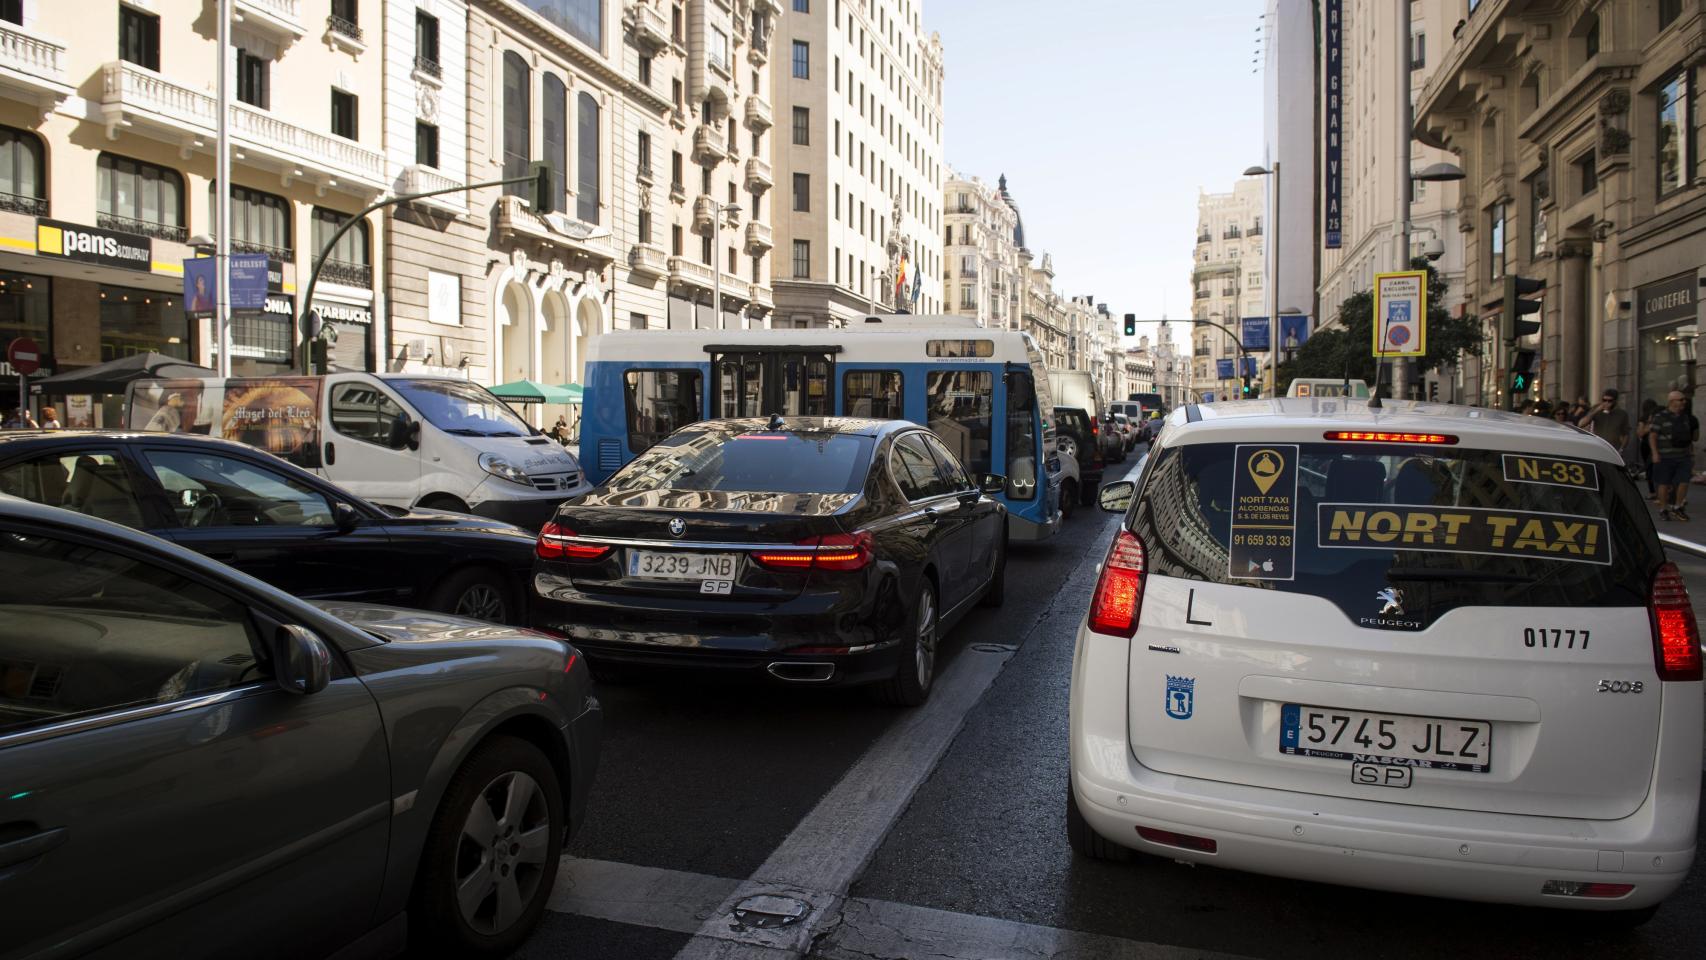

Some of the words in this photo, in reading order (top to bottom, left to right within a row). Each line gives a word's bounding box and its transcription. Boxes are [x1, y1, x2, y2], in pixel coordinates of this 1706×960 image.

[1328, 218, 1339, 230] 25
[63, 230, 118, 257] pans
[1645, 289, 1690, 314] CORTEFIEL
[311, 303, 372, 324] STARBUCKS
[268, 407, 282, 418] del
[1518, 458, 1585, 485] N-33
[1240, 496, 1265, 504] NORT
[1267, 496, 1289, 504] TAXI
[1234, 534, 1245, 545] 91
[1247, 534, 1264, 546] 659
[1265, 535, 1278, 546] 33
[1279, 535, 1291, 547] 33
[1329, 510, 1471, 545] NORT
[1487, 515, 1600, 556] TAXI
[642, 555, 690, 574] 3239
[696, 557, 732, 577] JNB
[703, 581, 730, 593] SP
[1186, 588, 1212, 626] L
[1360, 617, 1422, 628] PEUGEOT
[1523, 627, 1591, 650] 01777
[1287, 730, 1294, 739] E
[1307, 713, 1397, 751] 5745
[1412, 723, 1480, 758] JLZ
[1311, 751, 1344, 759] PEUGEOT
[1352, 753, 1433, 769] NASCAR
[1359, 766, 1405, 785] SP
